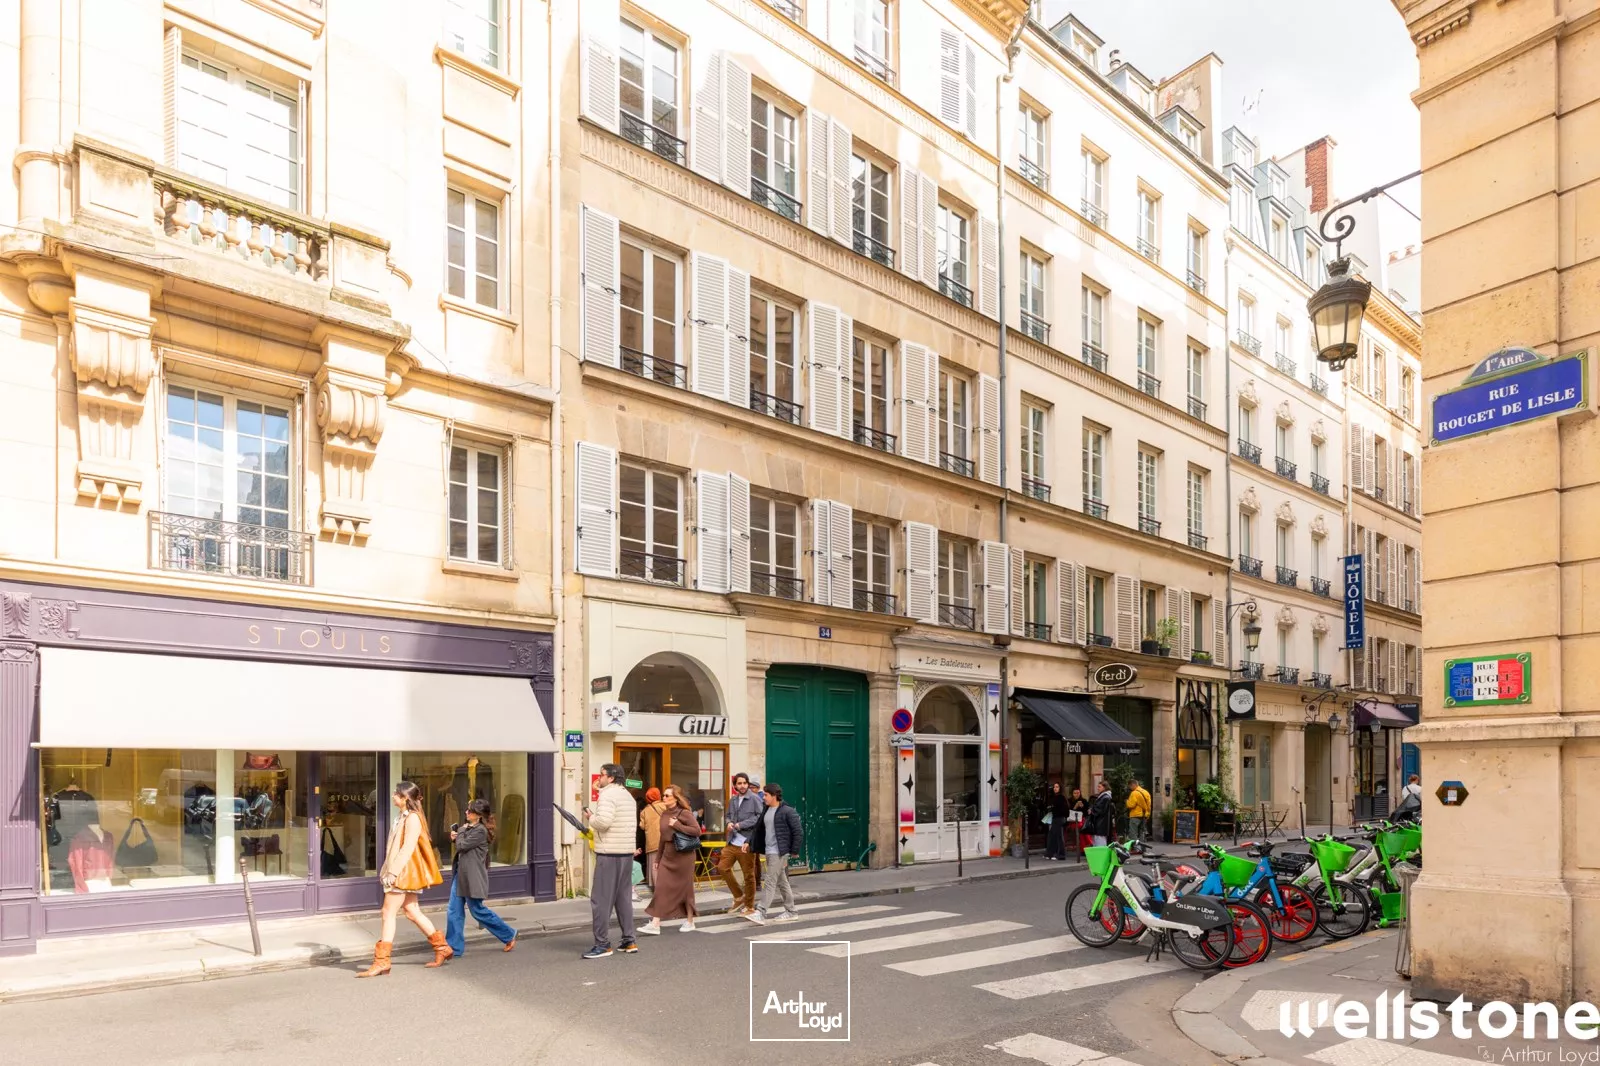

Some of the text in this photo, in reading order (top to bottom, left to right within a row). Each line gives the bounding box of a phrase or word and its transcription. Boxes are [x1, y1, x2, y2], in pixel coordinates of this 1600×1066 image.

[1489, 384, 1519, 401] RUE
[1438, 388, 1575, 432] ROUGET DE LISLE
[1347, 572, 1360, 635] HÔTEL
[820, 628, 831, 637] 34
[248, 625, 391, 653] STOULS
[925, 656, 938, 665] Les
[1101, 668, 1127, 680] ferdi
[1256, 703, 1271, 715] TEL
[1184, 903, 1197, 911] Lime
